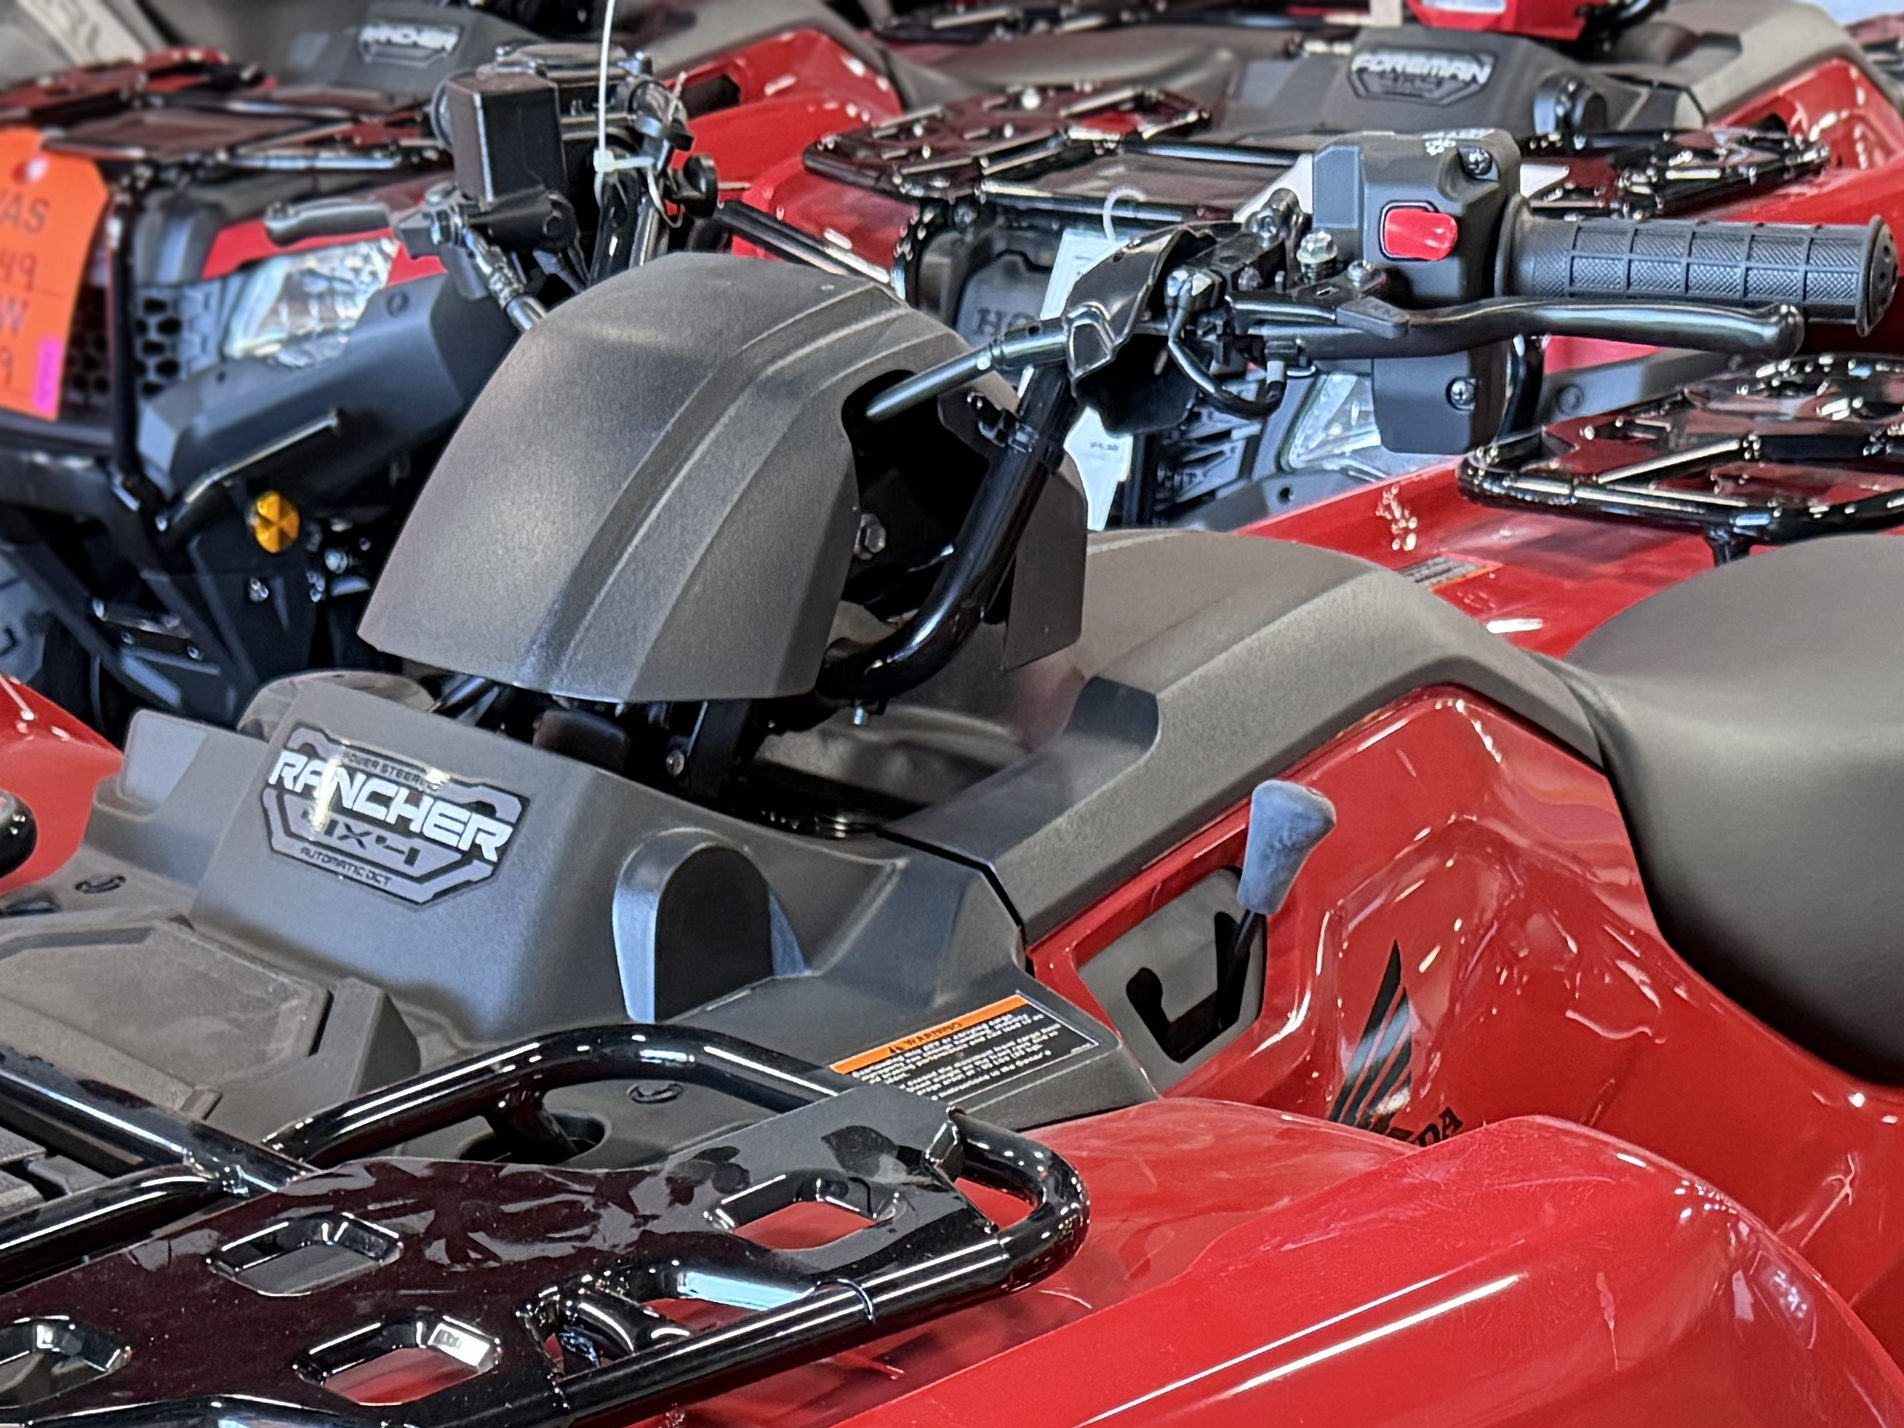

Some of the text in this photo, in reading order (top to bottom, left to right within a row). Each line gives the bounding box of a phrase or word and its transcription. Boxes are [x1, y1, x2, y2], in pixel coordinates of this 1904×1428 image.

[1351, 51, 1492, 86] FOREMAN
[268, 750, 514, 863] RANCHER
[300, 846, 367, 877] AUTOMATIC
